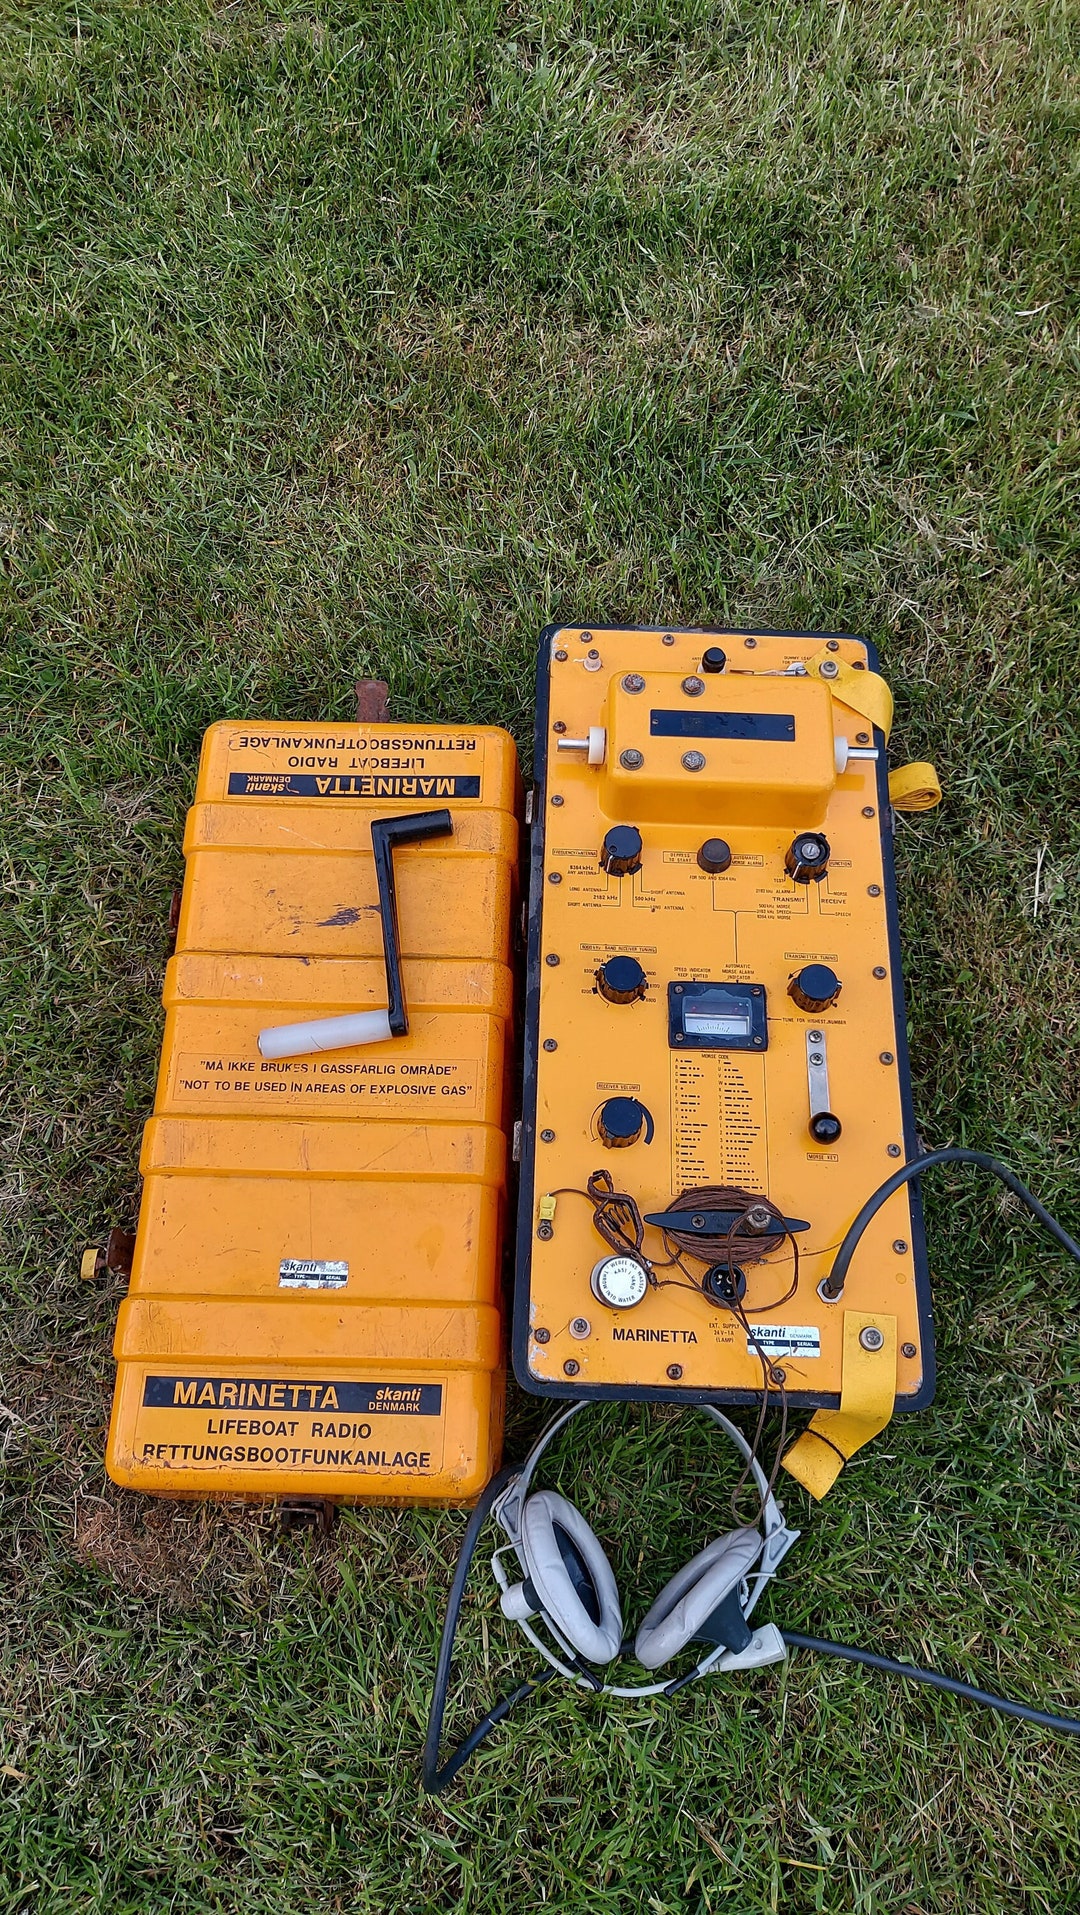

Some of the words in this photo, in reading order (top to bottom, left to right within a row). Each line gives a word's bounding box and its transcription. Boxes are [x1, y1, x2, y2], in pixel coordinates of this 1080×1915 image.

[288, 756, 338, 768] RADIO
[349, 757, 425, 769] LIFEBOAT
[247, 775, 291, 783] DENMARK
[245, 782, 284, 794] skanti
[316, 776, 456, 796] MARINETTA
[228, 1062, 256, 1072] IKKE
[260, 1062, 308, 1073] BRUKES
[313, 1064, 316, 1073] I
[320, 1064, 396, 1074] GASSFARLIG
[214, 1081, 230, 1091] TO
[234, 1082, 250, 1091] BE
[254, 1082, 286, 1092] USED
[290, 1082, 302, 1092] IN
[306, 1083, 346, 1094] AREAS
[350, 1084, 366, 1094] OF
[370, 1084, 436, 1096] EXPLOSIVE
[283, 1262, 317, 1272] skanti
[612, 1328, 698, 1344] MARINETTA
[750, 1326, 786, 1338] skanti
[173, 1382, 339, 1409] MARINETTA
[376, 1387, 422, 1402] skanti
[368, 1402, 420, 1412] DENMARK
[207, 1418, 299, 1437] LIFEBOAT
[311, 1422, 372, 1439] RADIO
[143, 1444, 431, 1468] RETTUNGSBOOTFUNKANLAGE
